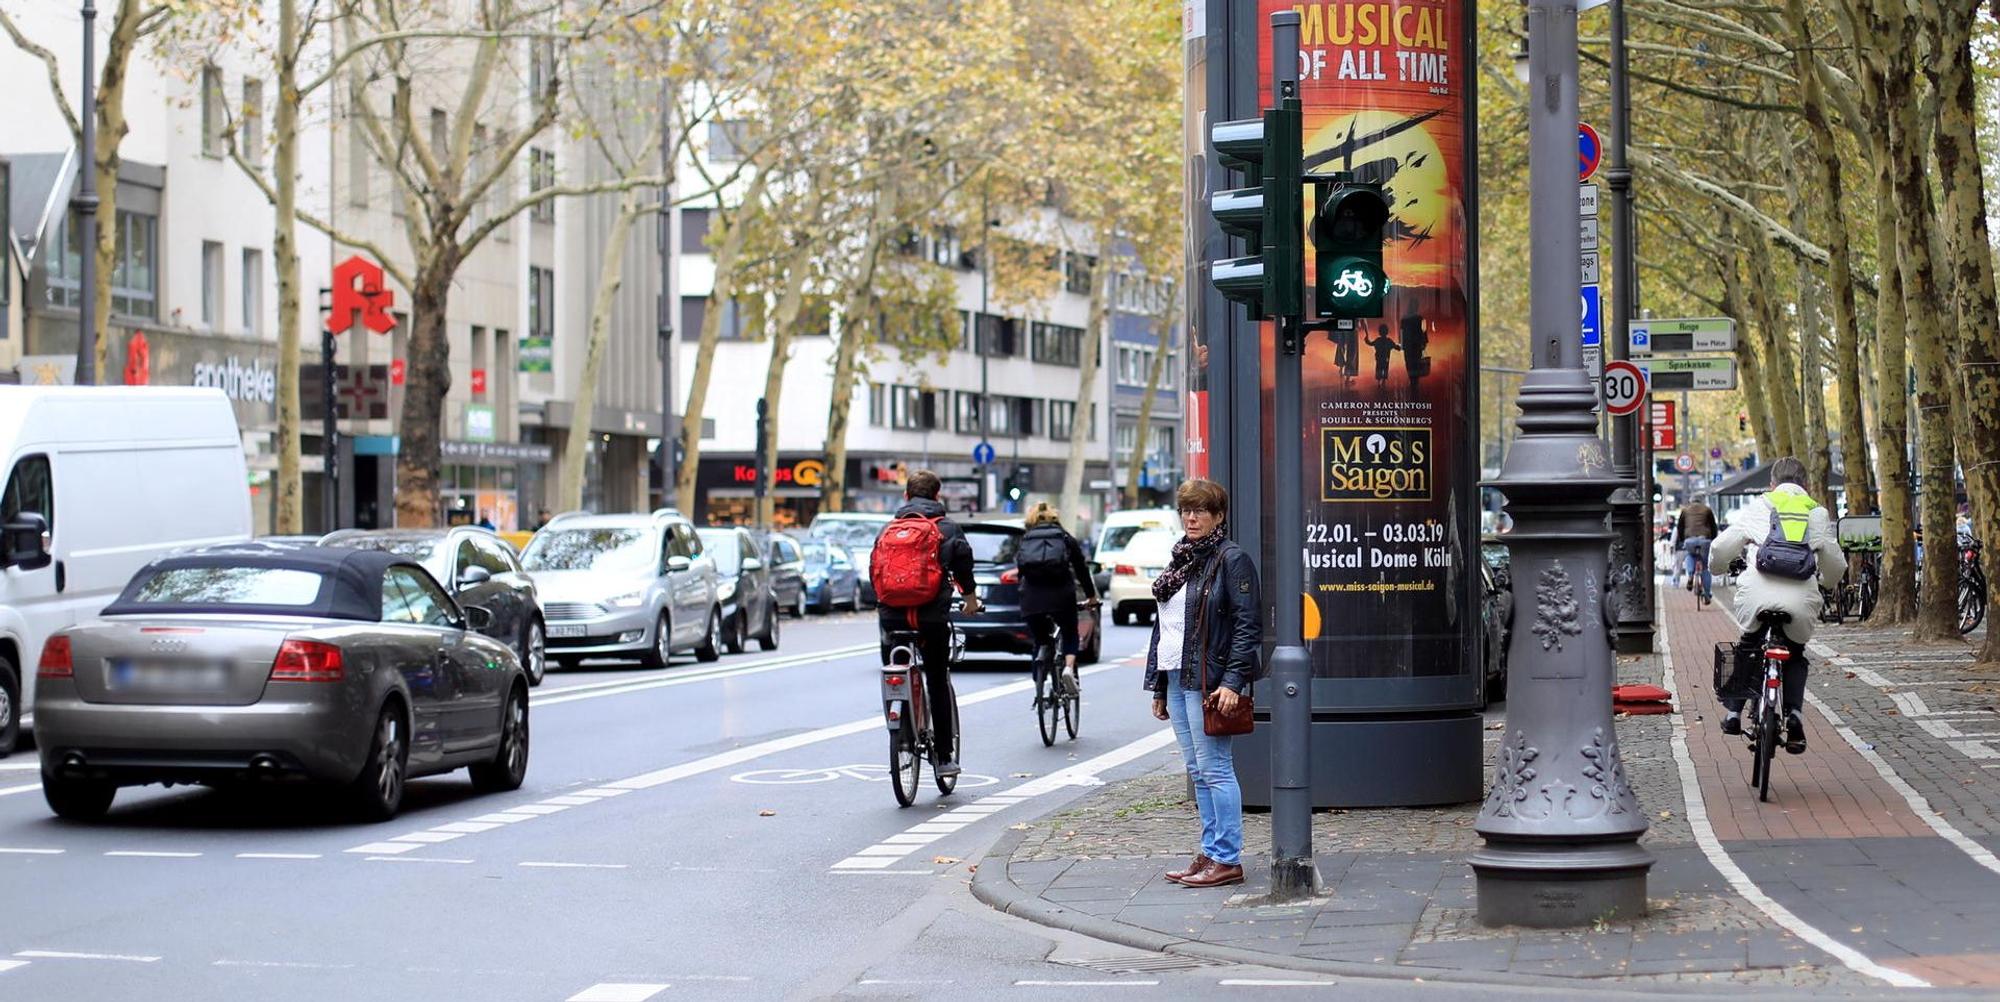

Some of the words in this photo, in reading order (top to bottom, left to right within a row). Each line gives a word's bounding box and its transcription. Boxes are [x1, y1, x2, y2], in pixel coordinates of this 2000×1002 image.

[1293, 4, 1448, 49] MUSICAL
[1338, 50, 1387, 81] ALL
[1396, 51, 1448, 85] TIME
[1668, 360, 1712, 370] Sparkasse
[194, 356, 276, 403] apotheke
[1606, 376, 1634, 400] 30
[1321, 402, 1370, 410] CAMERON
[1373, 402, 1432, 410] MACKINTOSH
[734, 465, 793, 483] Kaps
[1331, 463, 1427, 498] Saigon
[1306, 524, 1359, 543] 22.01.
[1382, 523, 1444, 543] 03.03.19
[1370, 547, 1418, 568] Dome
[1424, 546, 1452, 568] Köln
[1318, 580, 1435, 593] www.miss-saigon-musical.de
